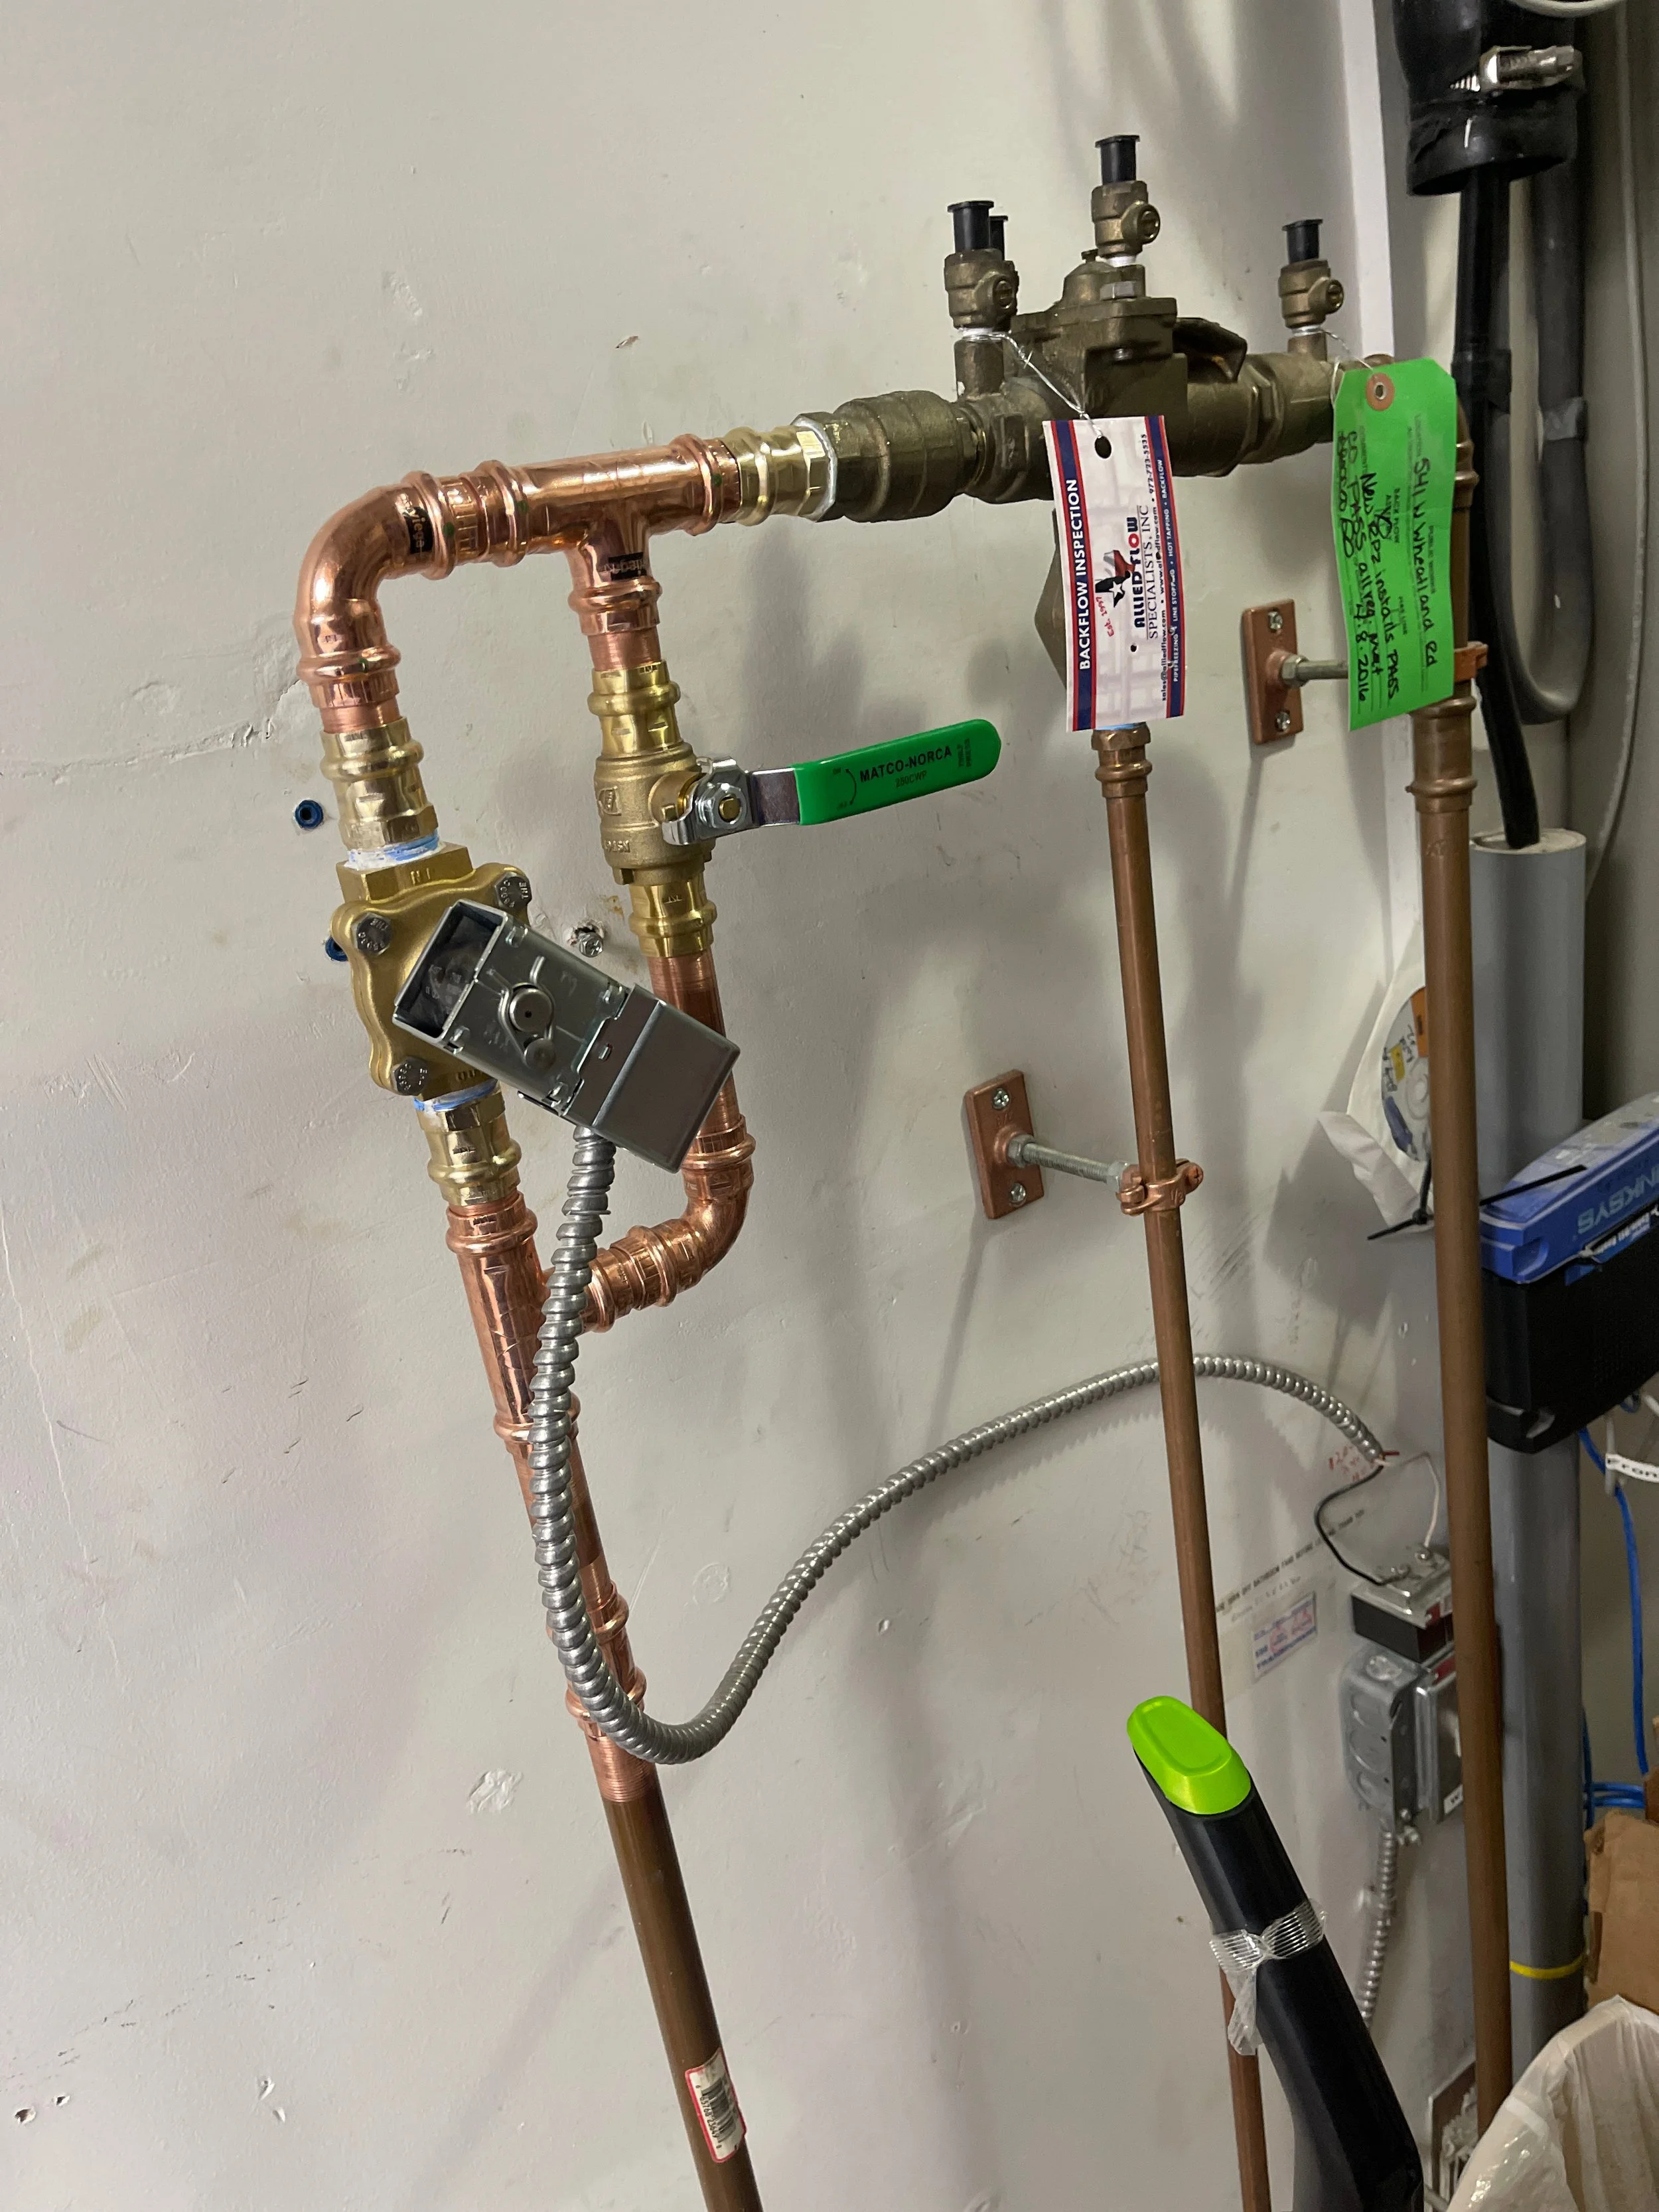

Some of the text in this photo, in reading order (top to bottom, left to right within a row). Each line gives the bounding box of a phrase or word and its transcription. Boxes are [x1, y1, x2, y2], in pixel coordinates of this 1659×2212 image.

[1157, 459, 1167, 499] BACKFLOW
[1139, 504, 1151, 532] INC
[1163, 508, 1173, 540] TAPPING
[1127, 517, 1141, 565] FLOW
[1152, 507, 1165, 595] www.aldflow.com
[1165, 541, 1173, 557] HOT
[1066, 479, 1091, 670] BACKFLOW INSPECTION
[1144, 536, 1159, 639] SPECIALISTS,
[1096, 597, 1108, 617] 1997
[1131, 571, 1145, 628] ALLIED
[859, 745, 953, 783] MATCO-NORCA
